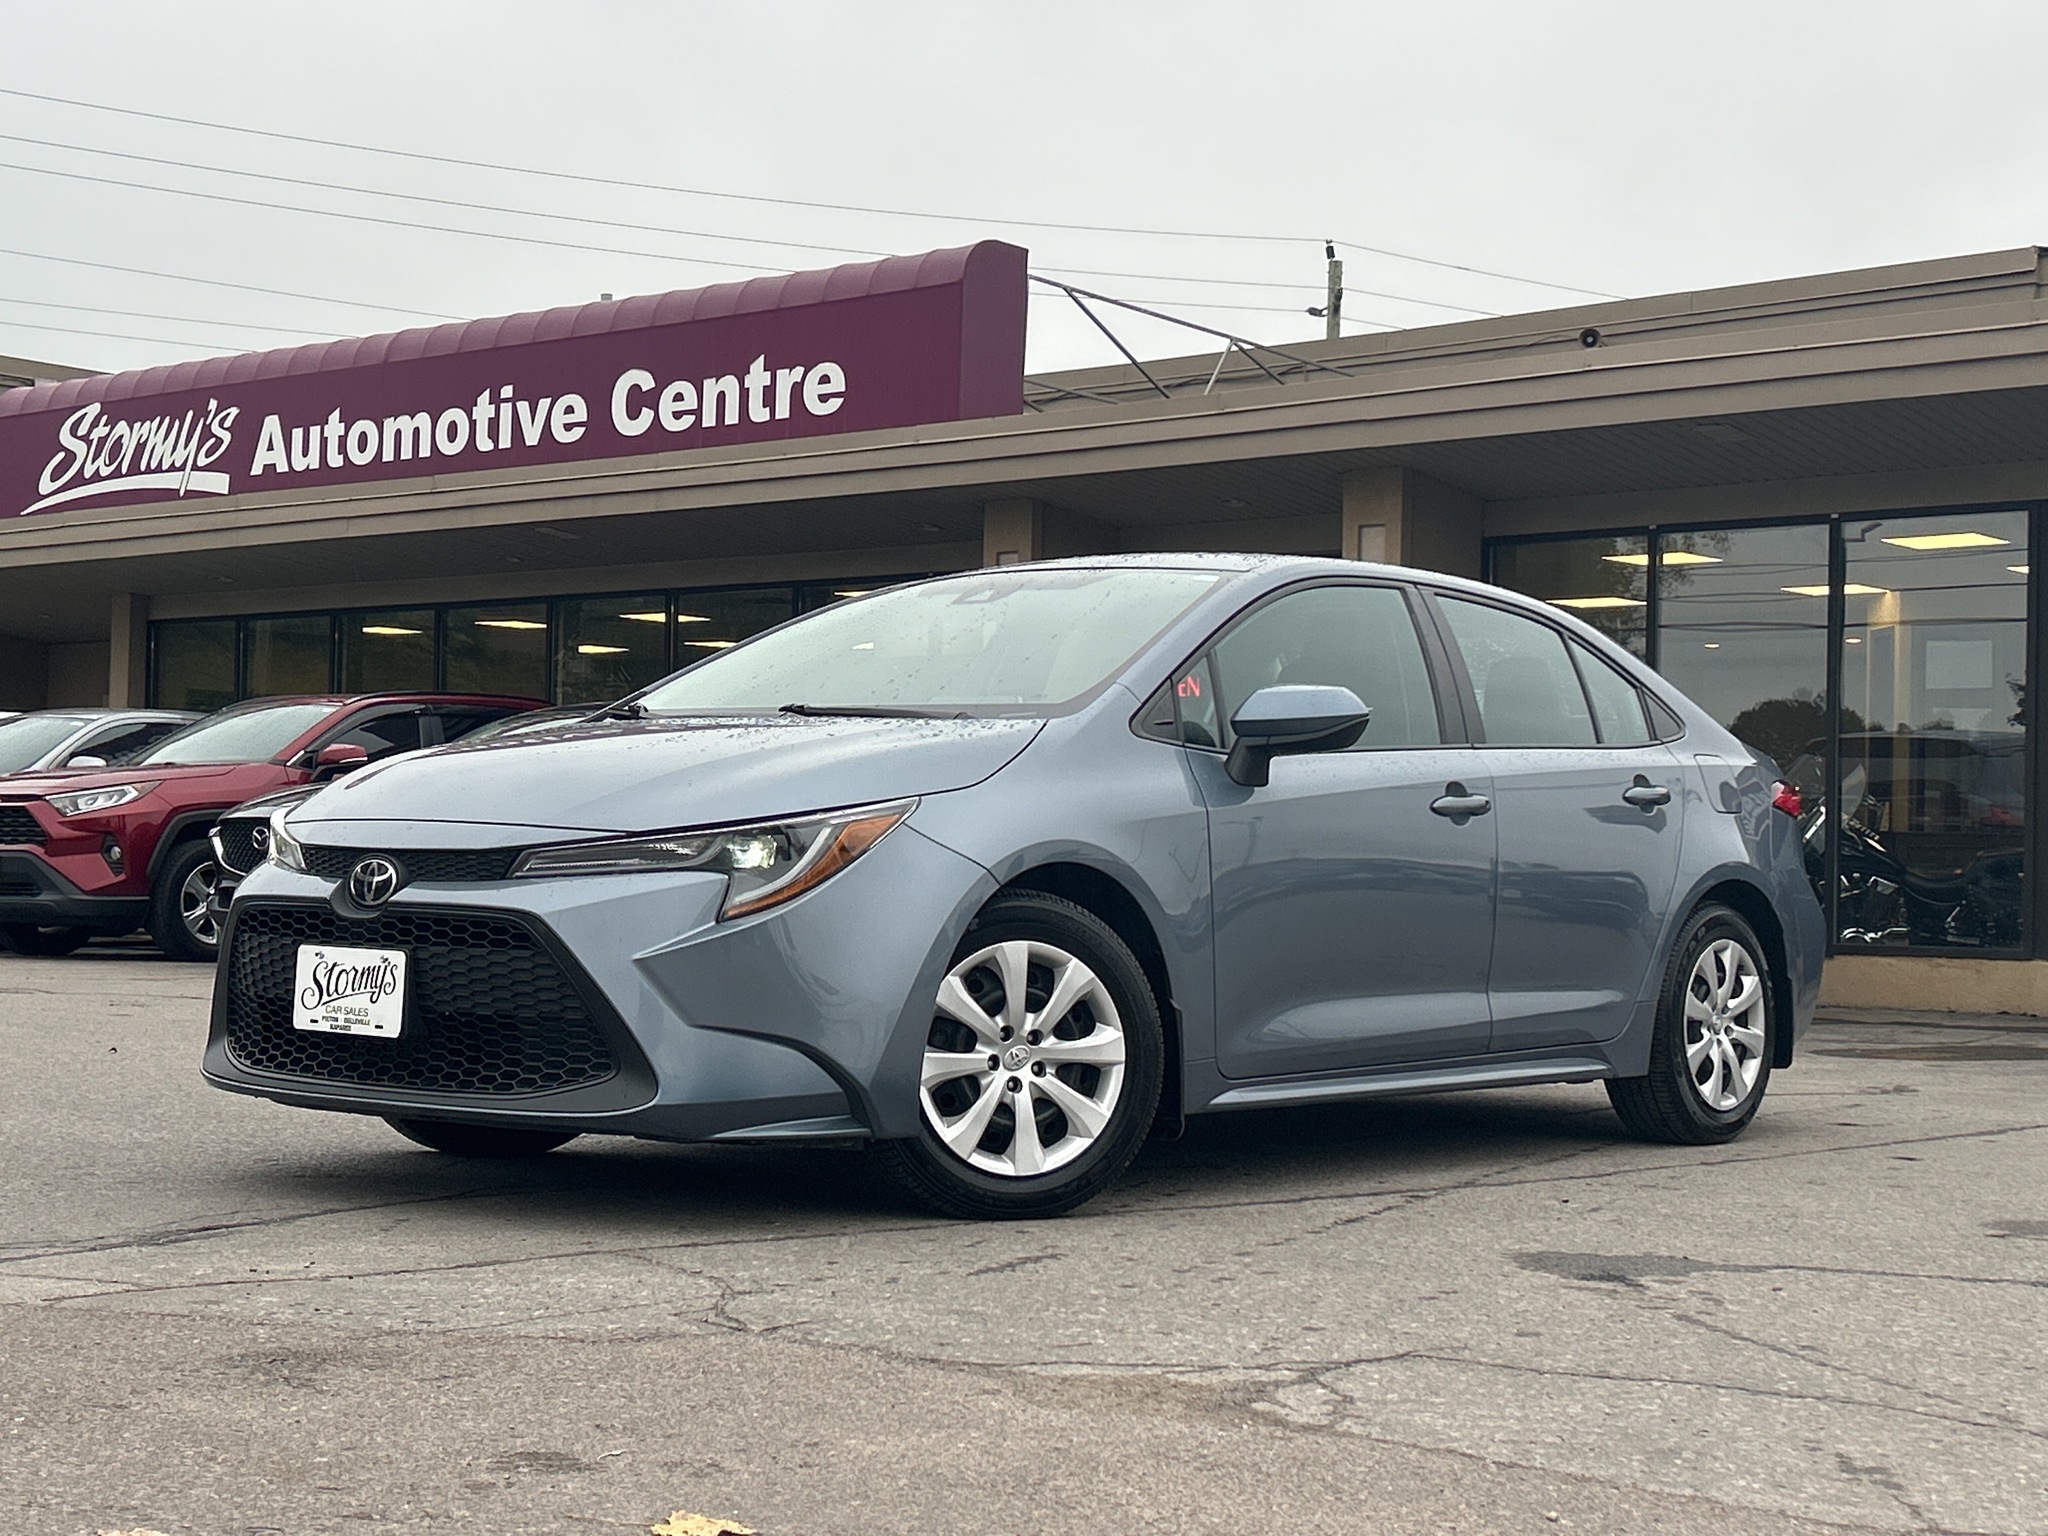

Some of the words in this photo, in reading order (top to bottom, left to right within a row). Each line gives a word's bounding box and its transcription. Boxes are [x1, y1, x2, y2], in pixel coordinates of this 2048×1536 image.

[38, 398, 239, 498] Stormy's
[250, 388, 588, 476] Automotive
[611, 354, 846, 437] Centre
[301, 960, 398, 1010] Stormy's
[325, 1005, 342, 1014] CAR
[343, 1006, 369, 1017] SALES
